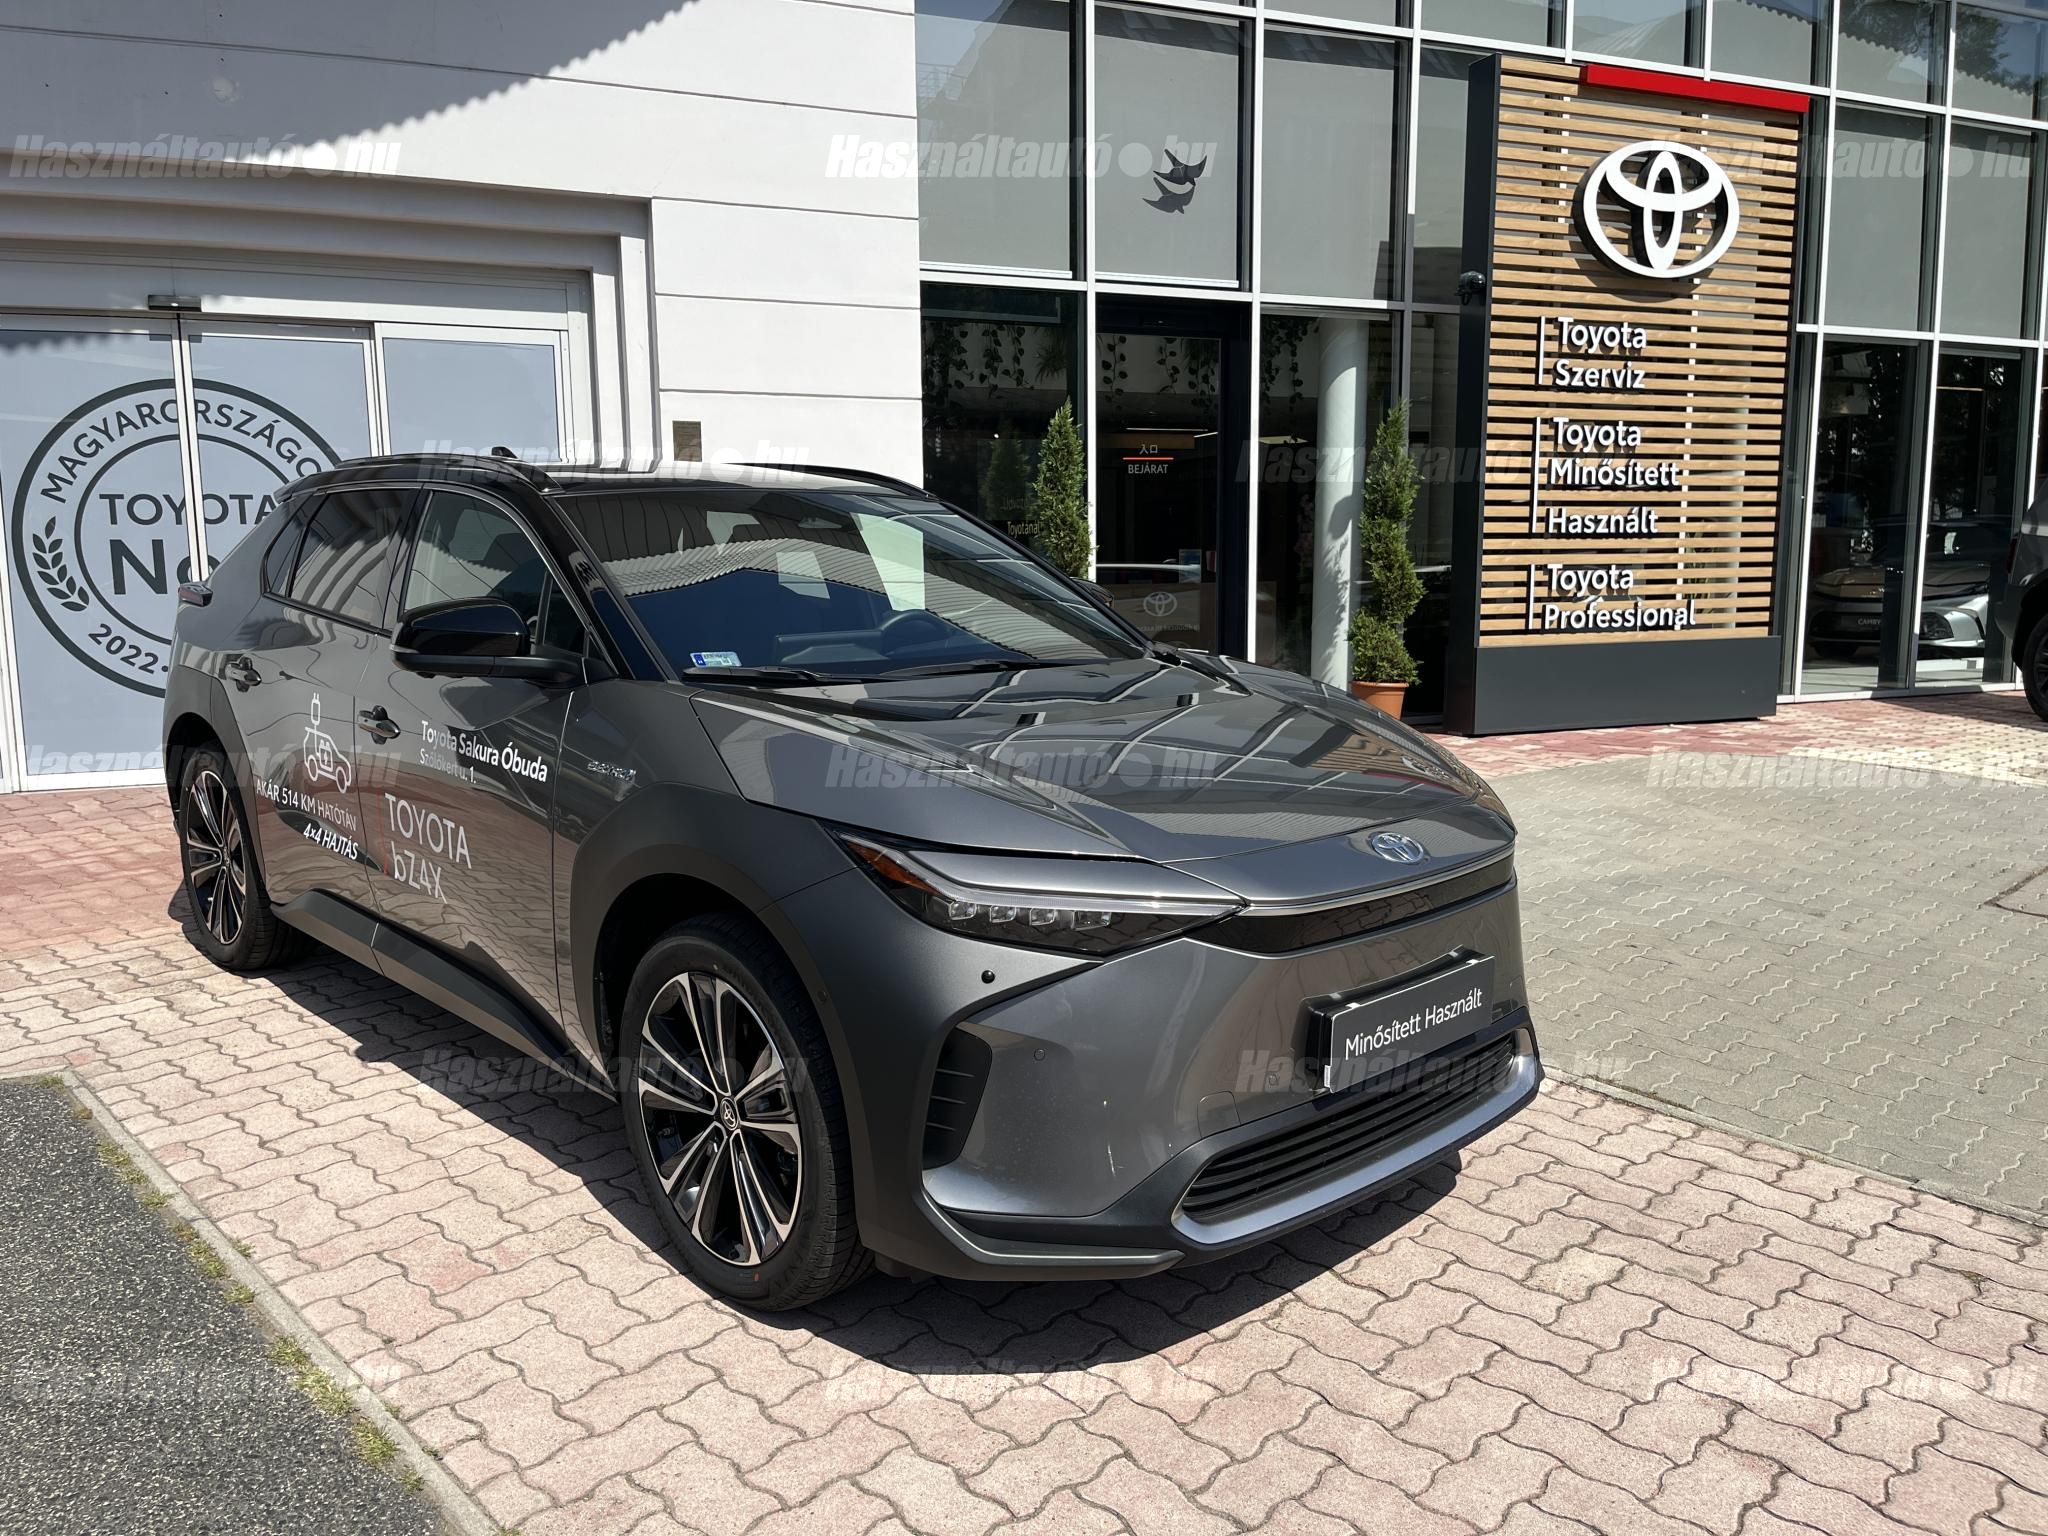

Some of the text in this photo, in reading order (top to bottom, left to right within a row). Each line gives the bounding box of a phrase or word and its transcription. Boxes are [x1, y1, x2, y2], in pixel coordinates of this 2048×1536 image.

[1558, 316, 1647, 354] Toyota
[1555, 359, 1646, 389] Szerviz
[1139, 444, 1158, 454] 入口
[1553, 417, 1641, 453] Toyota
[1128, 462, 1168, 474] BEJÁRAT
[1550, 458, 1680, 486] Minősített
[99, 493, 276, 526] TOYOTA
[1549, 506, 1659, 534] Használt
[1547, 564, 1634, 597] Toyota
[1544, 599, 1696, 630] Professional
[421, 720, 457, 751] Toyota
[459, 733, 499, 766] Sakura
[501, 741, 548, 782] Óbuda
[257, 779, 357, 831] AKÁR 514 KM HATÓTÁV
[322, 830, 358, 860] HAJTÁS
[384, 792, 472, 869] TOYOTA
[391, 840, 447, 904] bZ4X
[1345, 987, 1482, 1060] Minősített Használt
